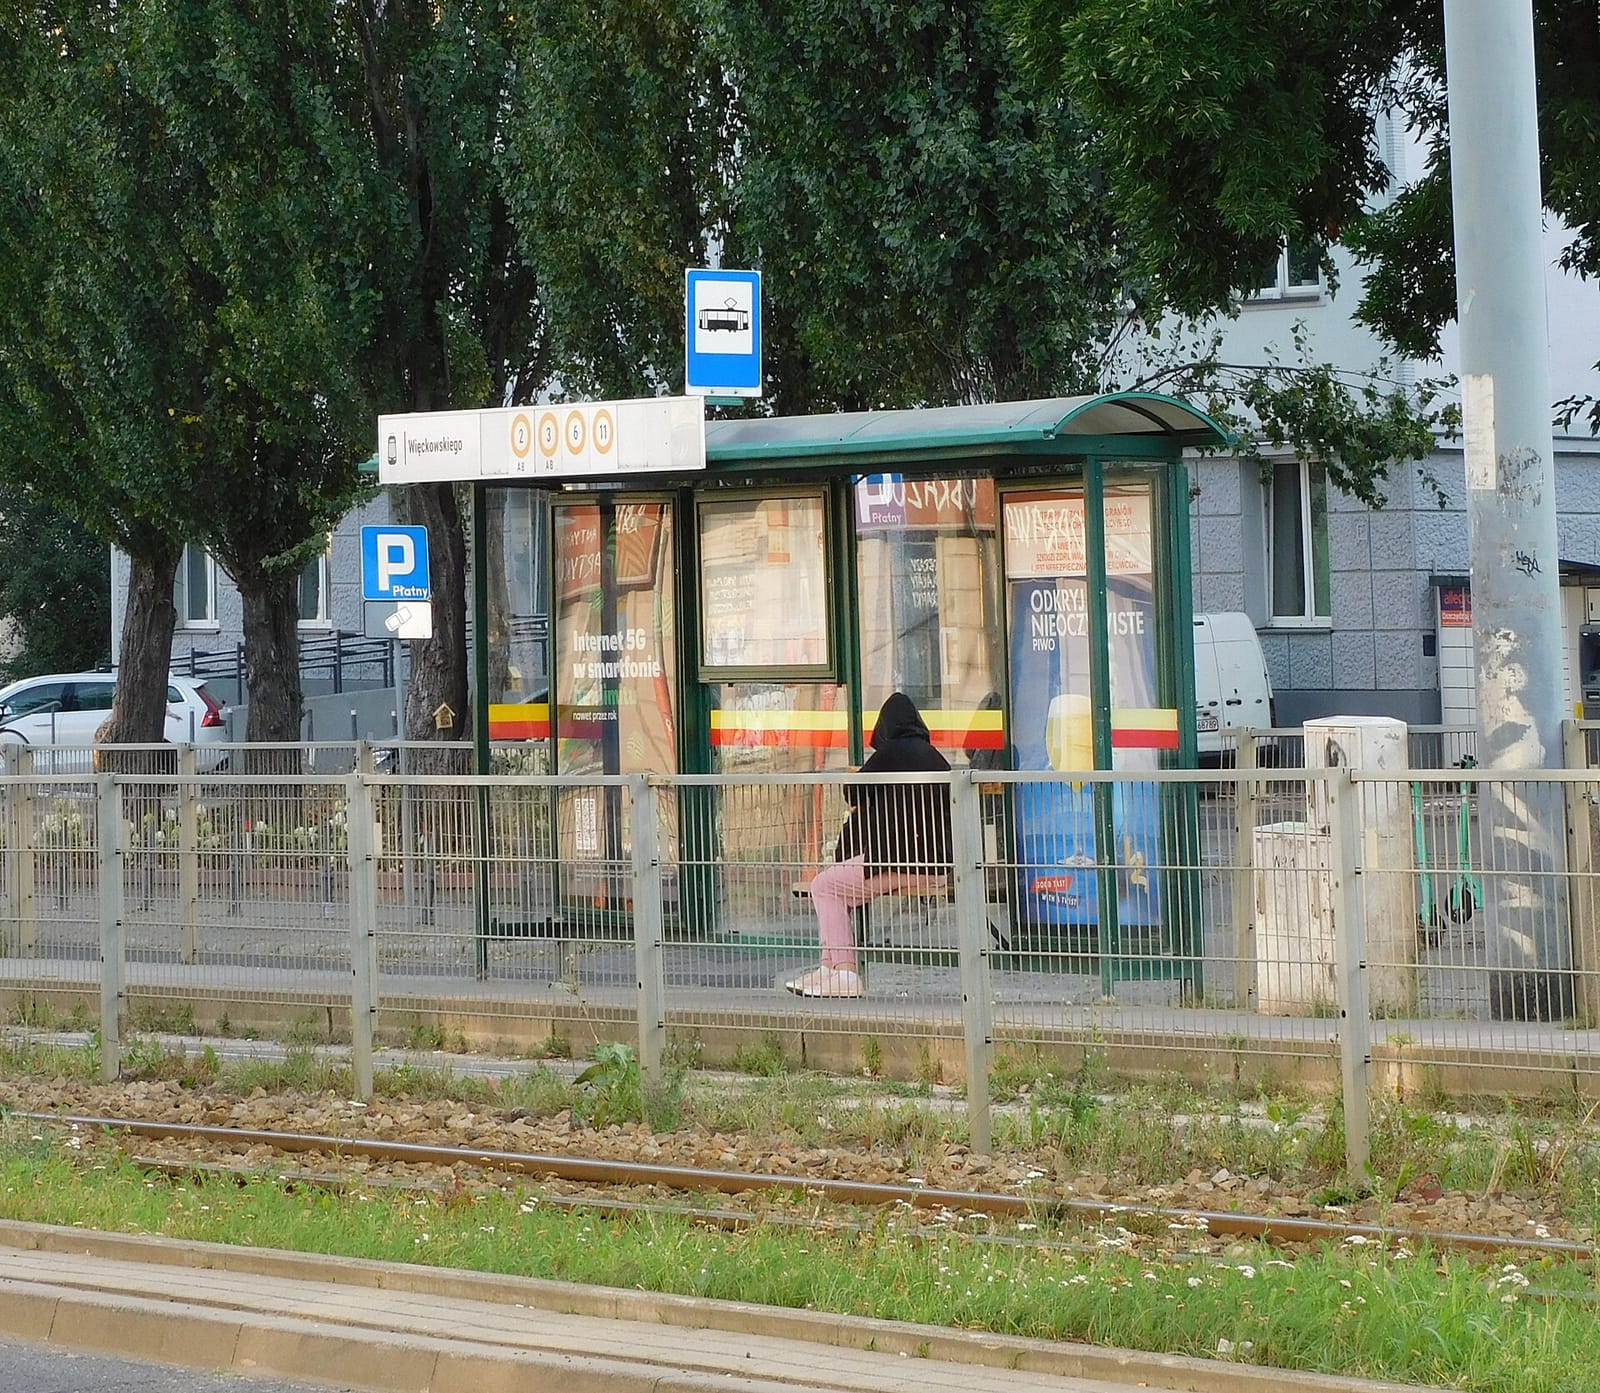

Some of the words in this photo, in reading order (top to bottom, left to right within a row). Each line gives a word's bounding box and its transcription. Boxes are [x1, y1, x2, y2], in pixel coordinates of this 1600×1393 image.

[518, 428, 524, 444] 2
[546, 427, 552, 442] 3
[573, 425, 579, 440] 6
[599, 424, 607, 440] 11
[408, 438, 463, 457] Więckowskiego
[377, 534, 415, 591] P
[393, 585, 428, 599] Płatny
[1030, 588, 1085, 613] ODKRYJ
[1031, 611, 1145, 637] NIEOCZISTE
[573, 630, 624, 651] Internet
[626, 628, 646, 650] 5G
[1032, 637, 1056, 651] PIWO
[573, 663, 586, 678] w
[588, 654, 661, 678] smartfonie
